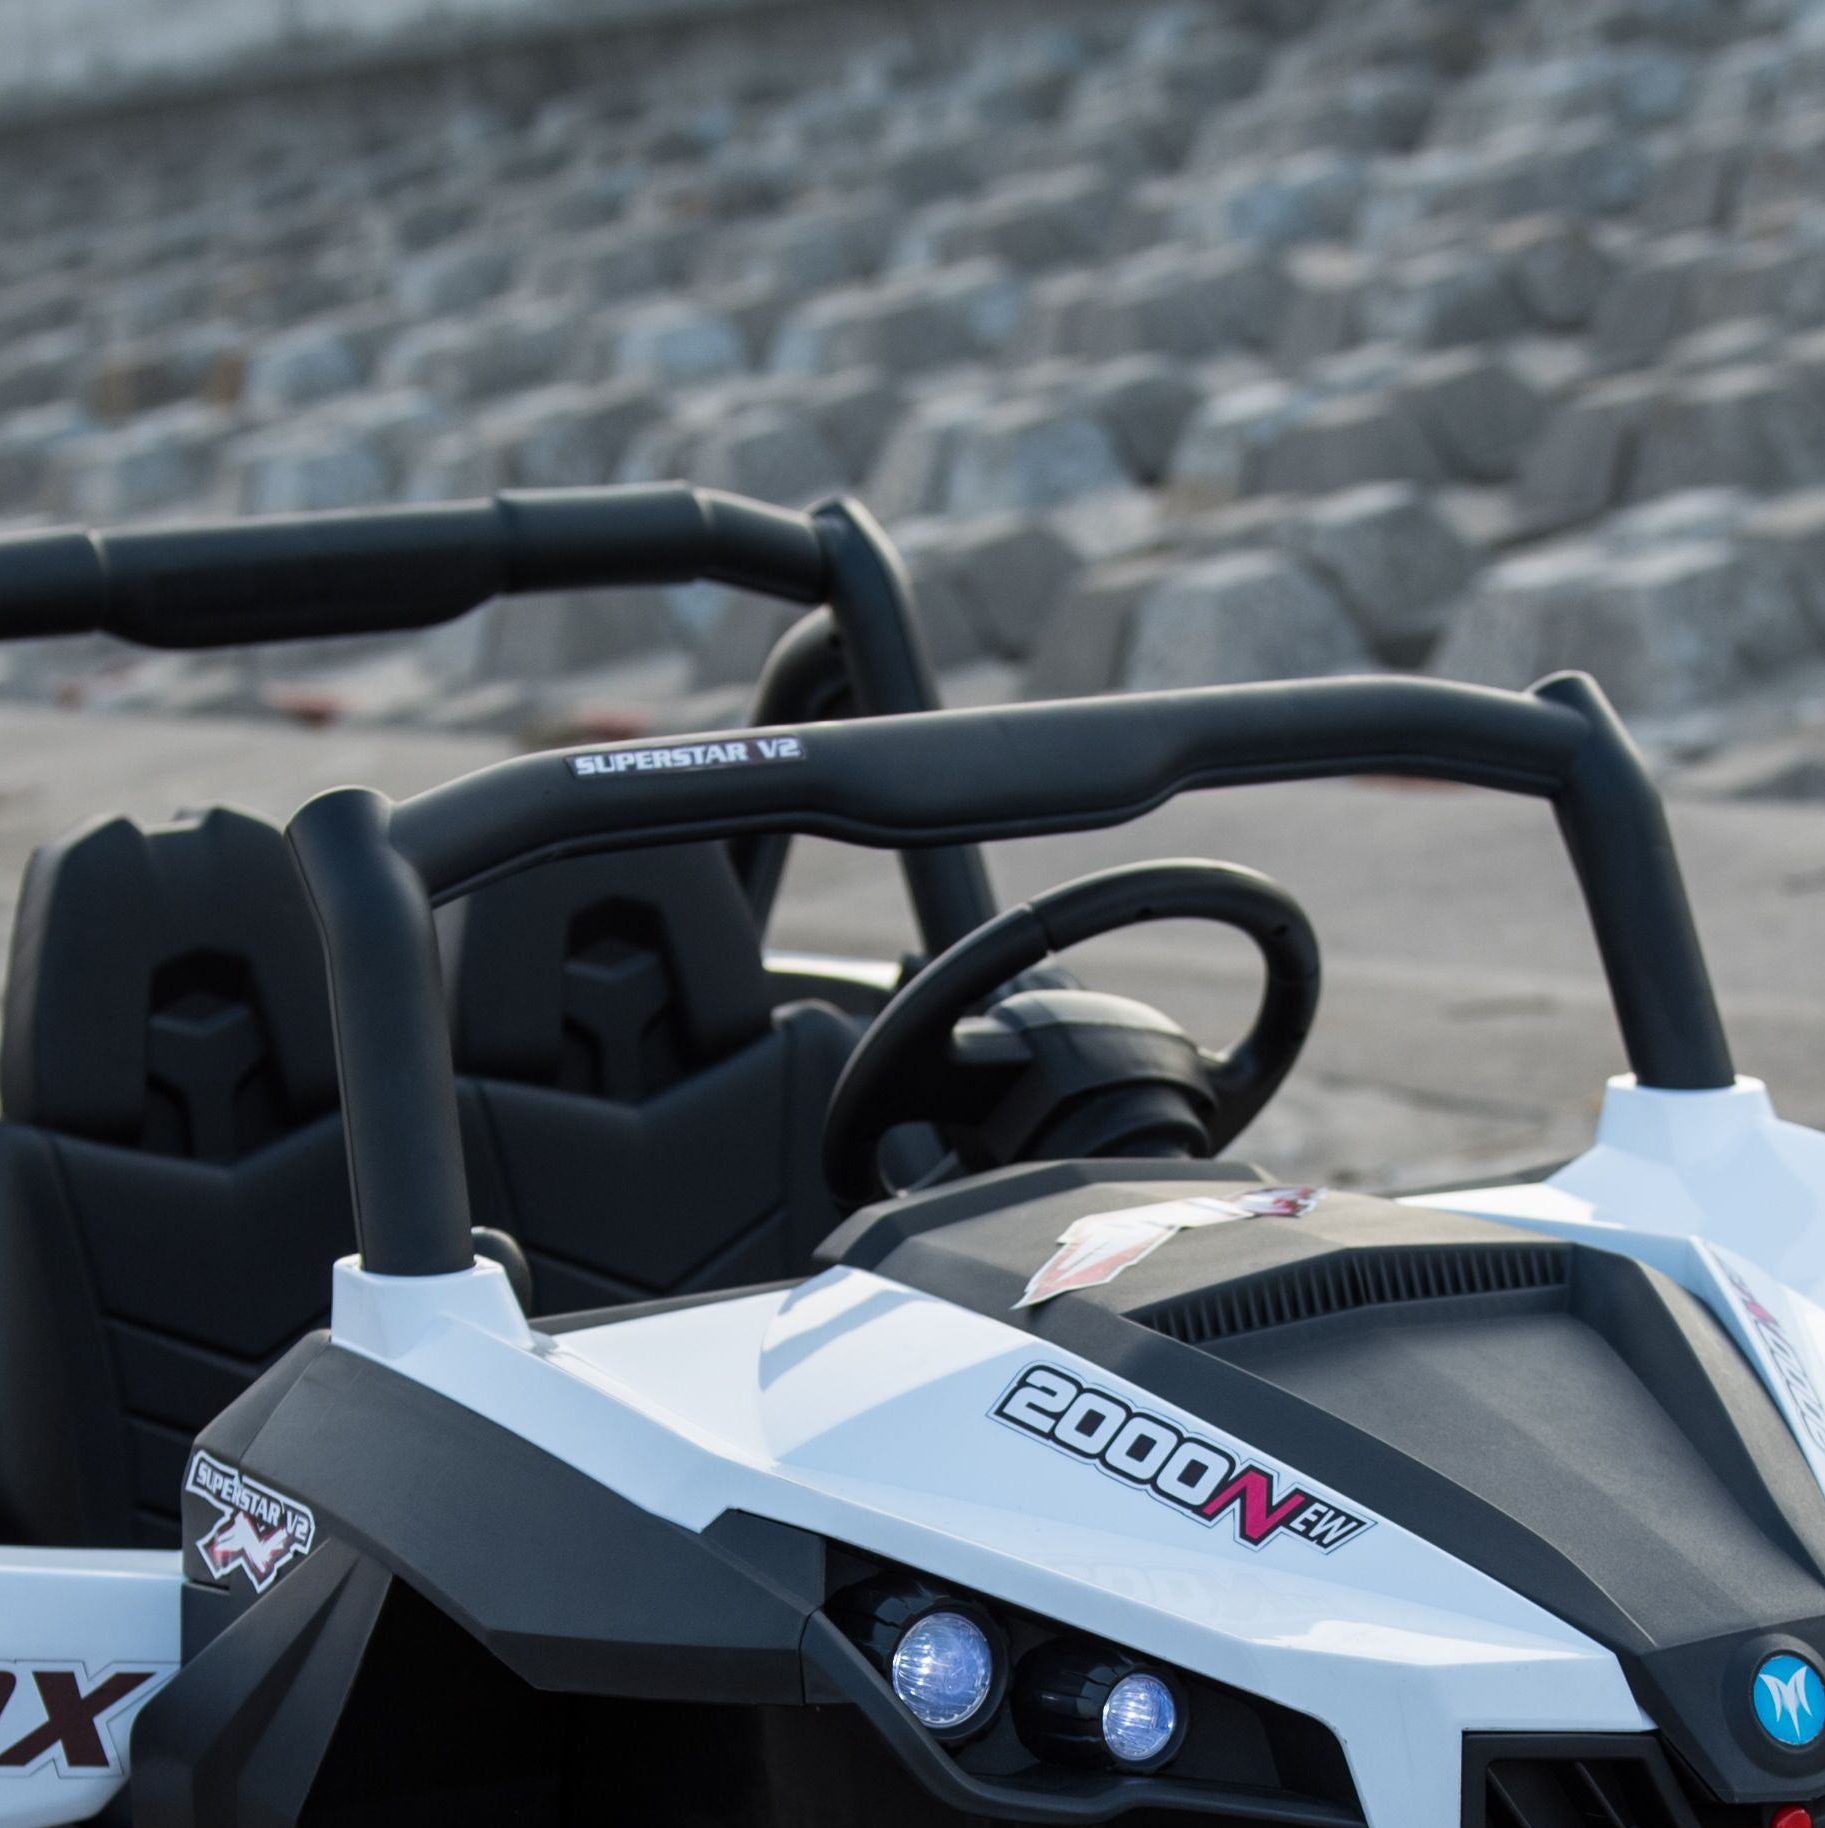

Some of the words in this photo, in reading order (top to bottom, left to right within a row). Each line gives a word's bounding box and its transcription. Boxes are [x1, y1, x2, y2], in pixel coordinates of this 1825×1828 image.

[575, 742, 750, 776] SUPERSTAR
[756, 736, 802, 760] V2
[196, 1461, 281, 1527] SUPERSTAR
[285, 1509, 310, 1542] V2
